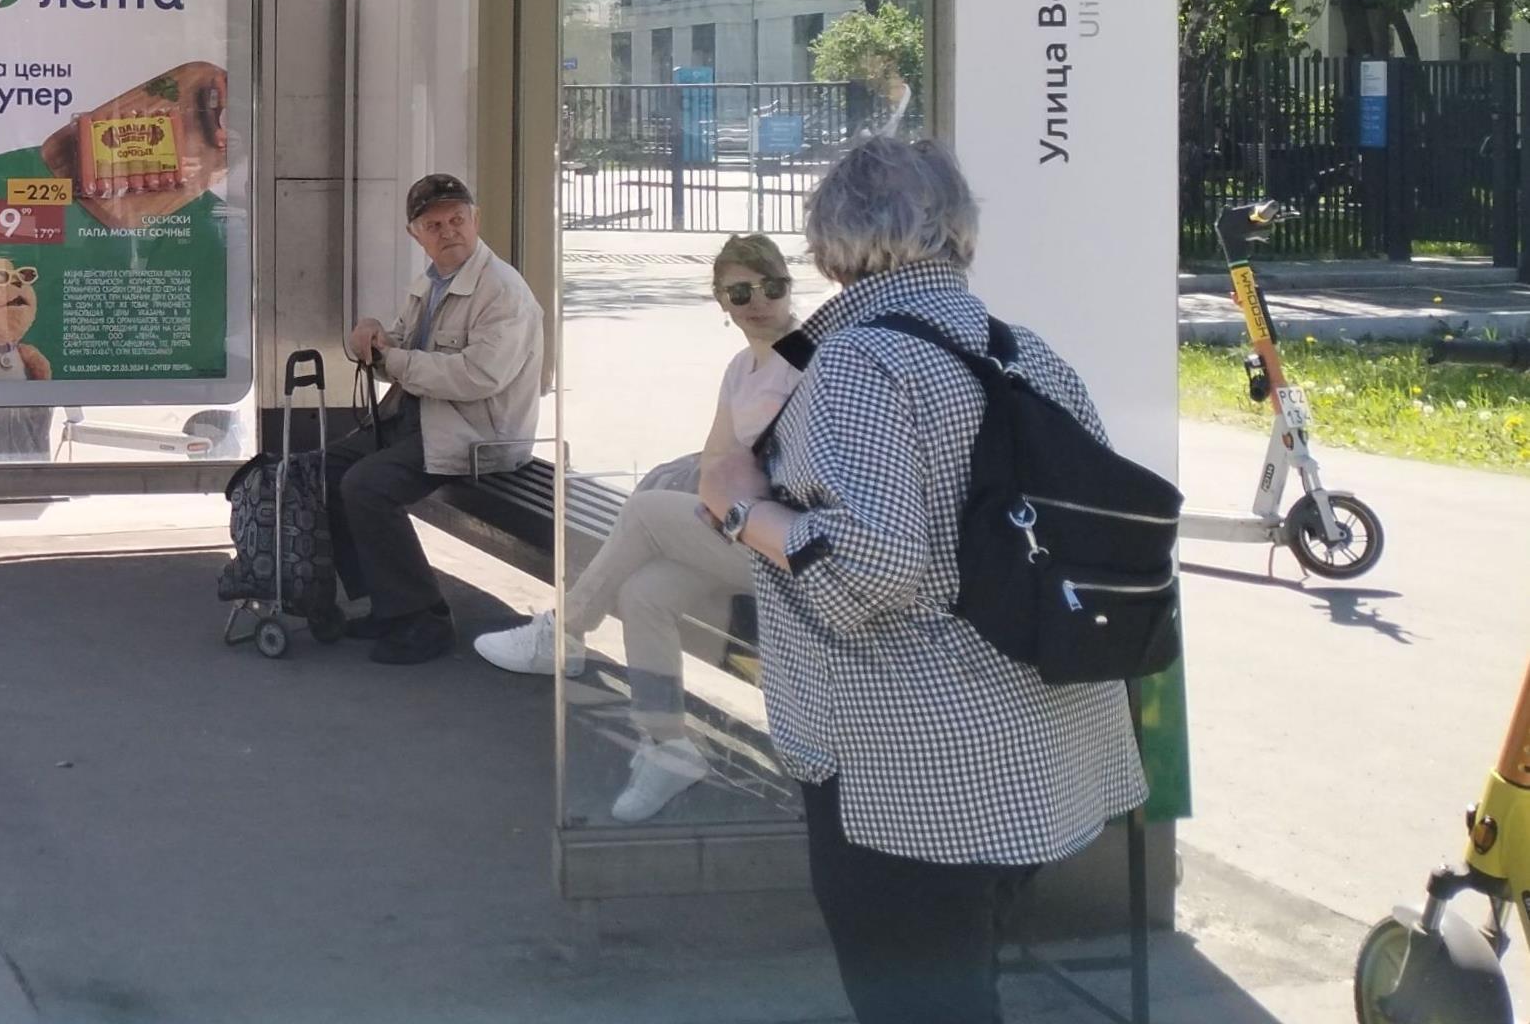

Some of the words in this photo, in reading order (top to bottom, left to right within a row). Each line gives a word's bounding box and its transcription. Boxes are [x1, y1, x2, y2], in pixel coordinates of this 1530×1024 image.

[15, 62, 72, 81] цены
[1039, 41, 1072, 165] Улица
[141, 215, 191, 225] СОСИСКИ
[78, 227, 108, 237] ПАПА
[110, 227, 146, 237] МОЖЕТ
[149, 227, 191, 237] СОЧНЫЕ
[1239, 272, 1269, 340] WHOOSH
